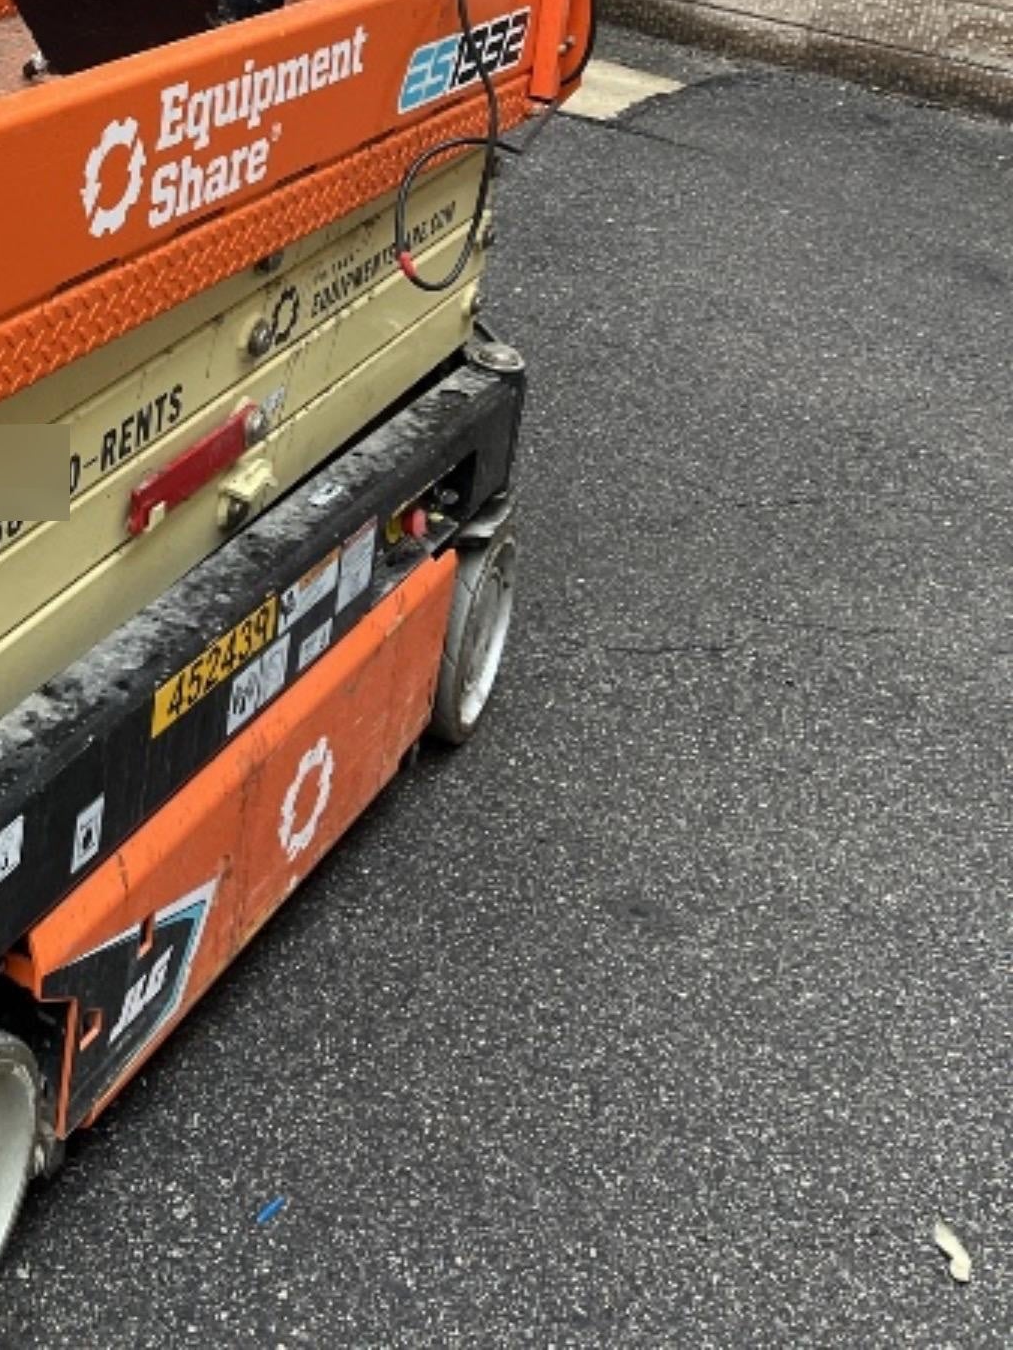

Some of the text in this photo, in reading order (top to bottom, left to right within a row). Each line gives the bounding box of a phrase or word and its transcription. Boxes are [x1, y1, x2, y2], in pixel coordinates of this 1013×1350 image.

[155, 25, 369, 151] Equipment
[166, 607, 272, 715] 452439
[108, 944, 175, 1043] JLG
